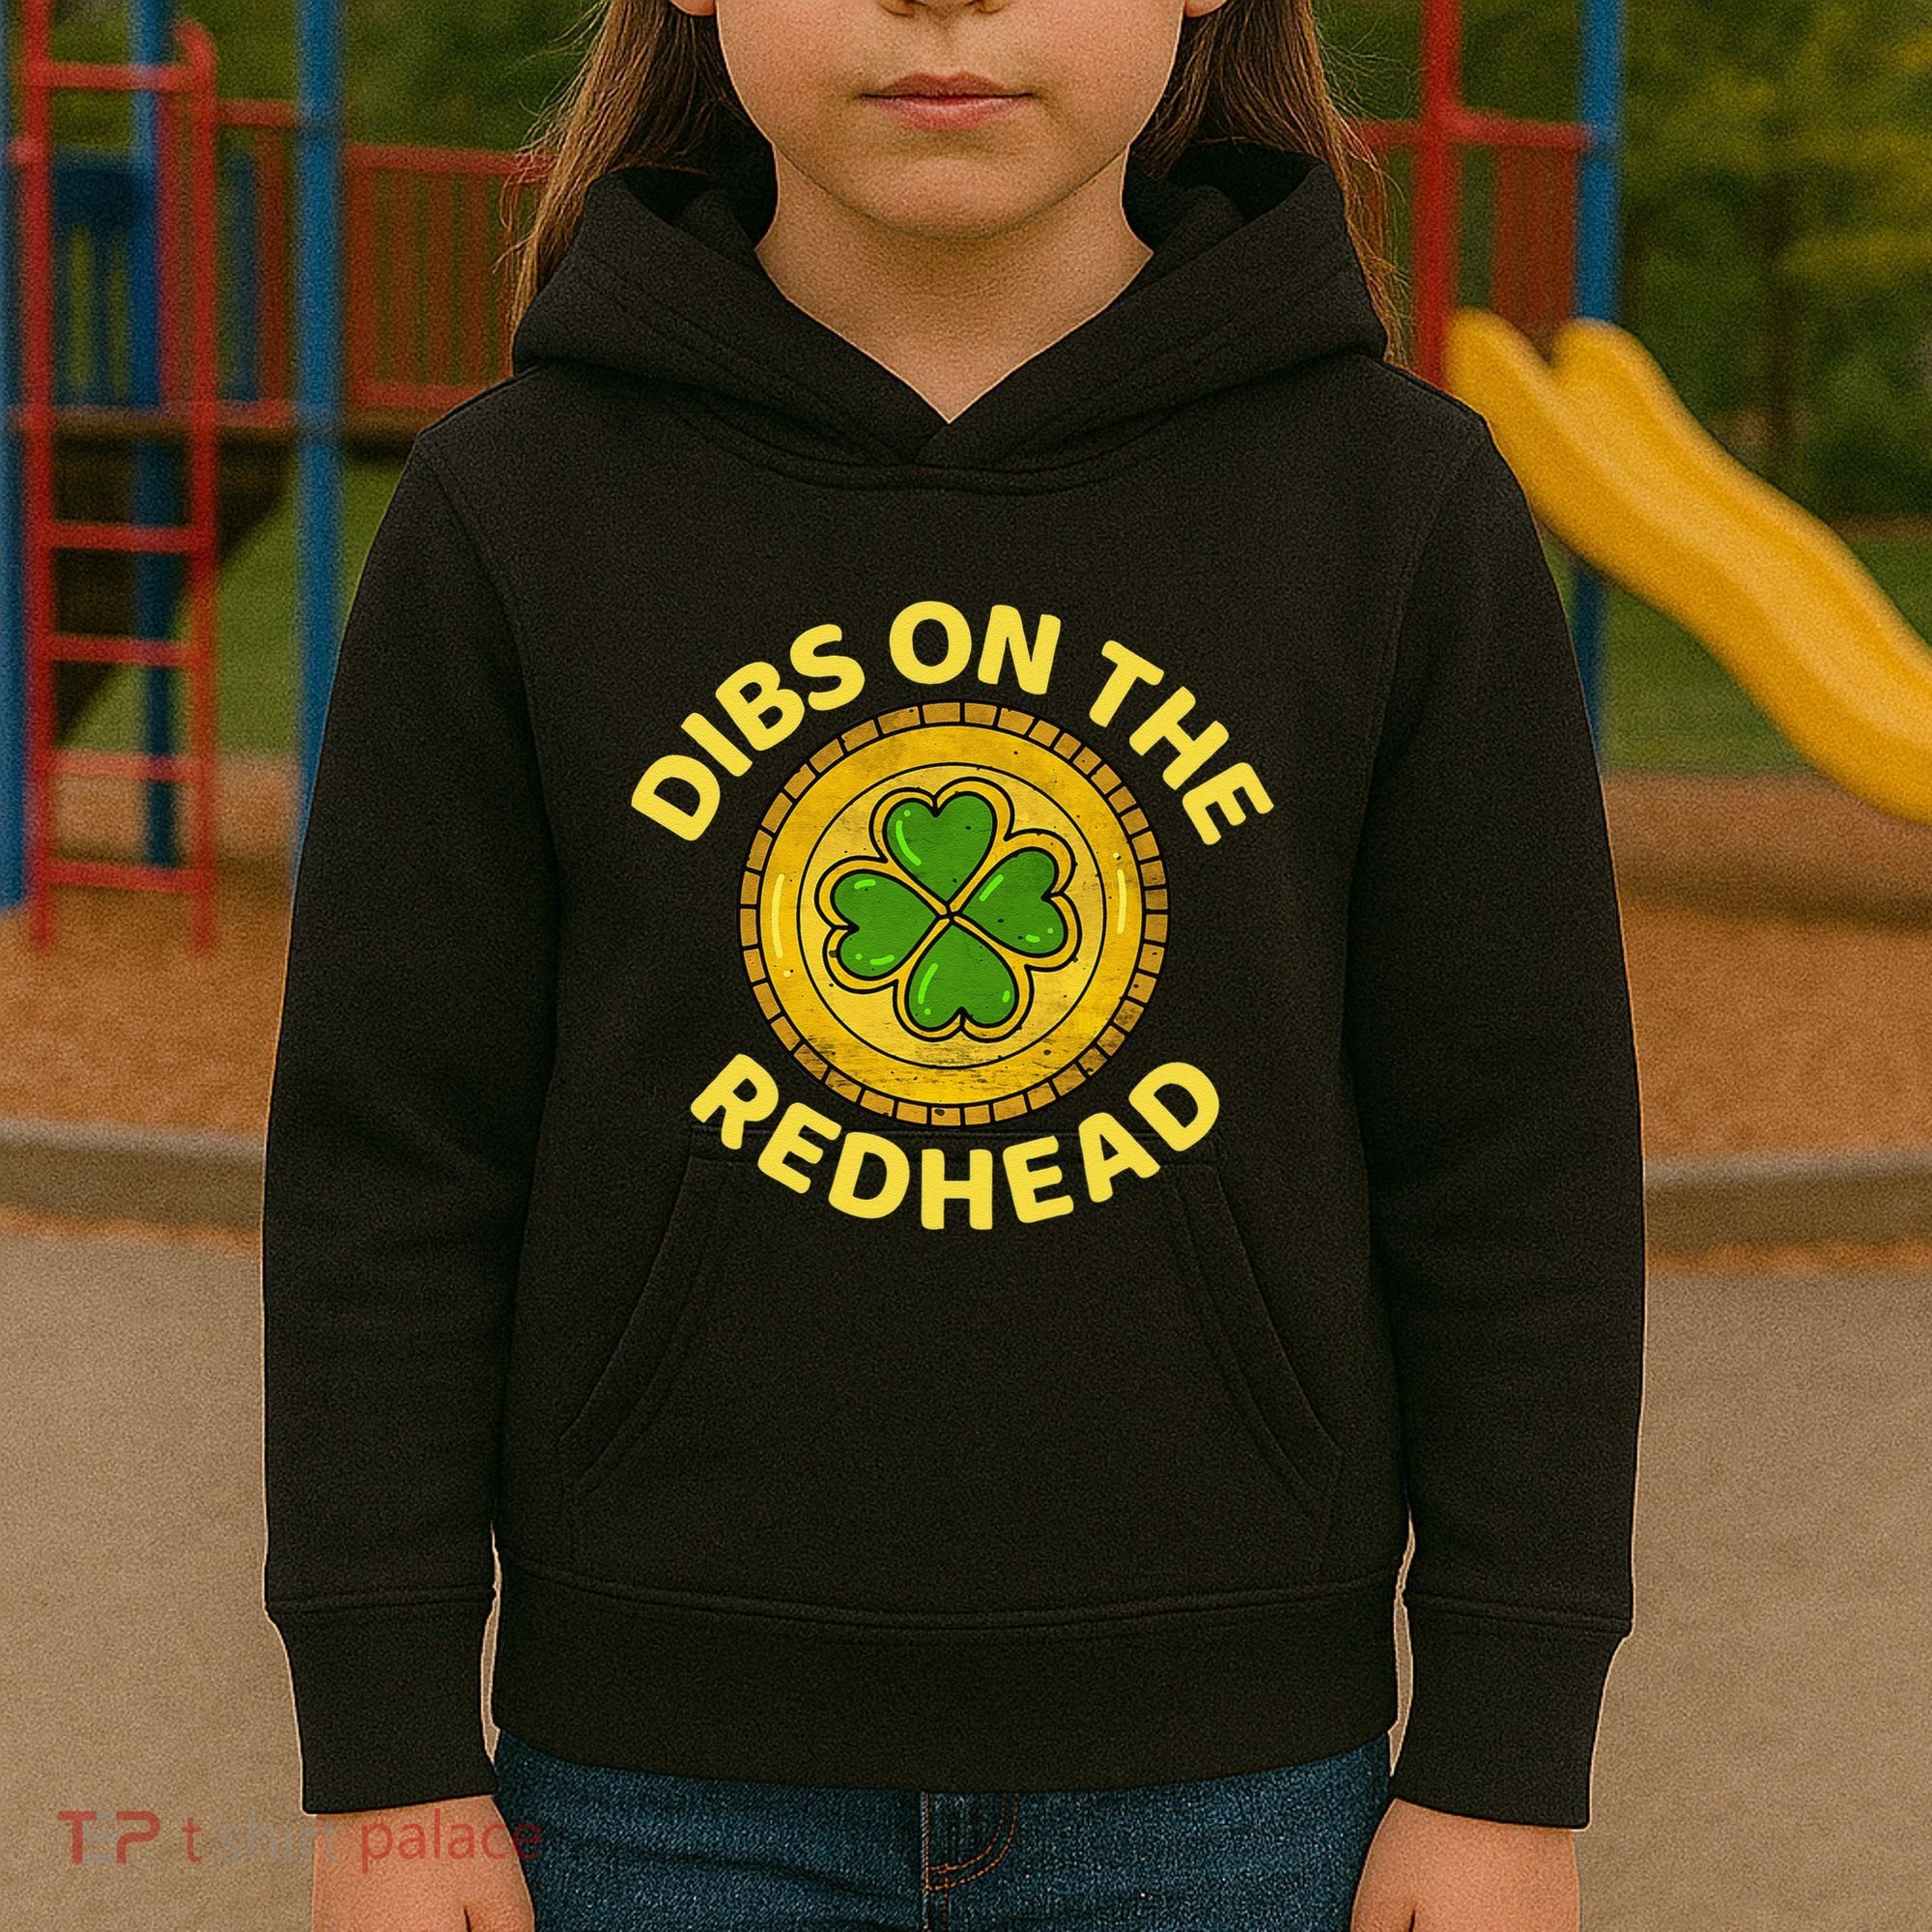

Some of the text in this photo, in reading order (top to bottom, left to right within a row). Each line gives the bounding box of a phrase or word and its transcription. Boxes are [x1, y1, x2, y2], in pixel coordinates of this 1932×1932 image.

[631, 600, 1274, 845] DIBS ON THE
[690, 1053, 1220, 1231] REDHEAD
